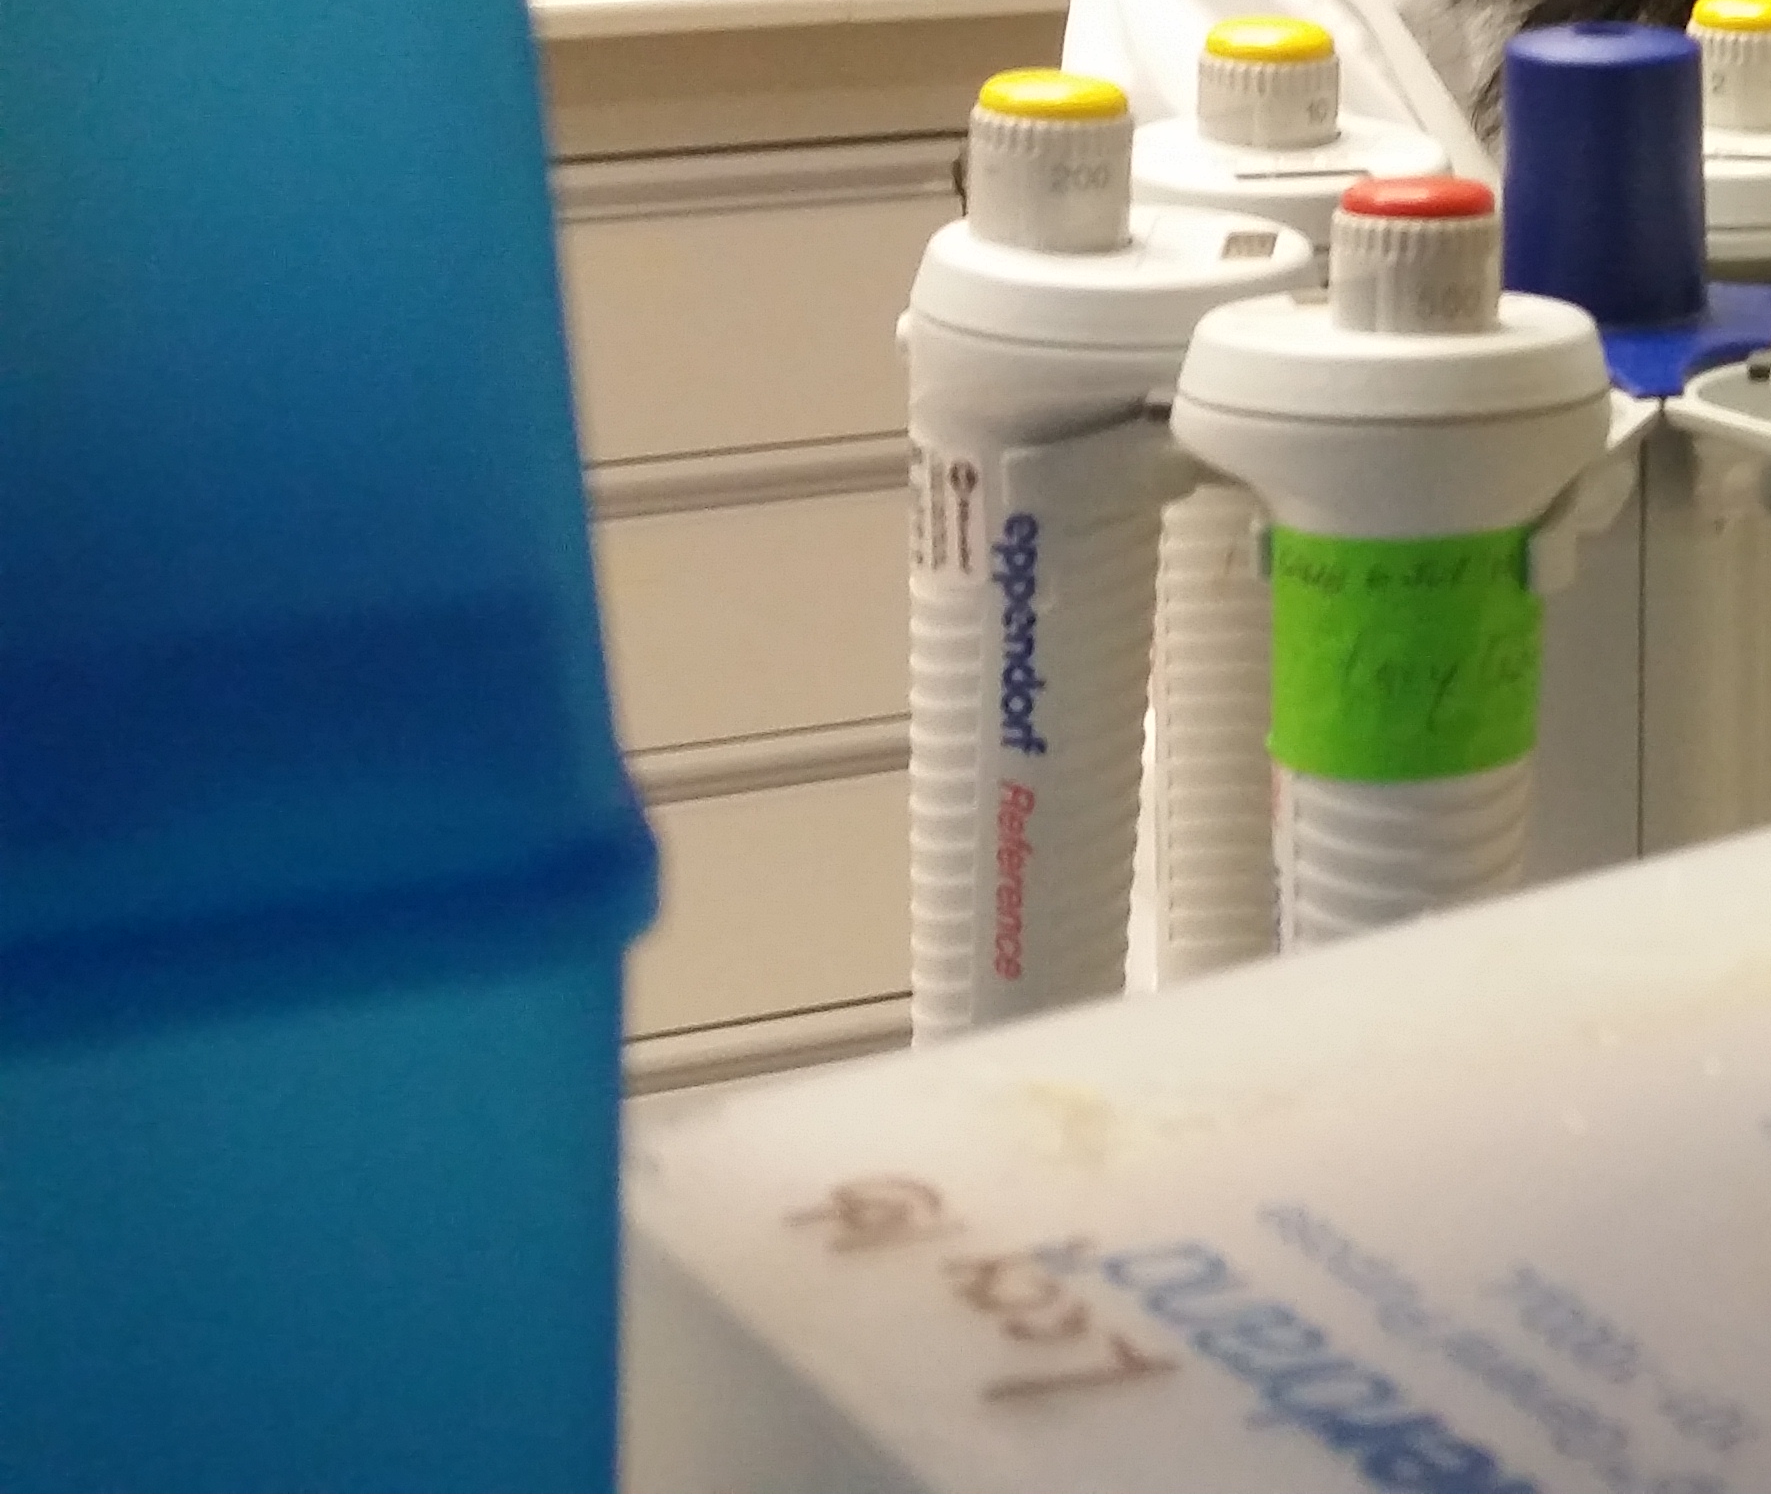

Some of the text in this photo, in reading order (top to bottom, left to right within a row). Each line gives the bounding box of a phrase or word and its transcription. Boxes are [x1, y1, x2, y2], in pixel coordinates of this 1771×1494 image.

[1050, 162, 1112, 193] 200
[990, 511, 1047, 981] eppendorf Reference
